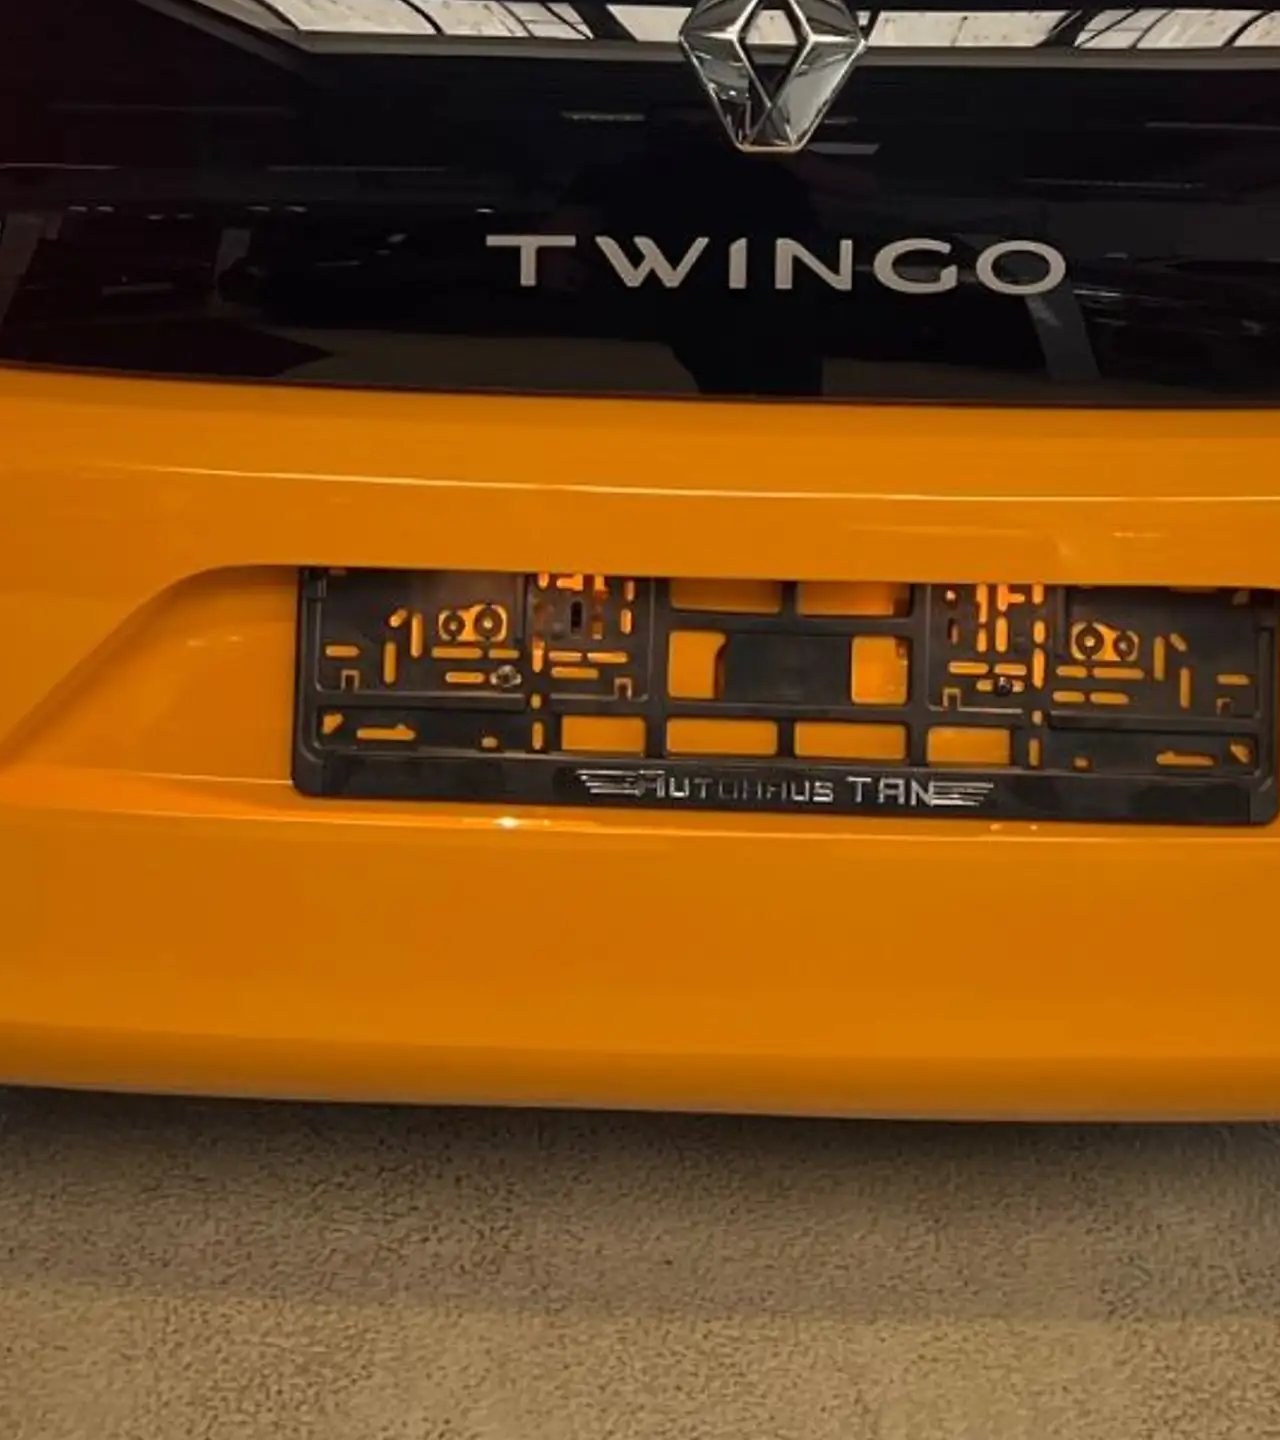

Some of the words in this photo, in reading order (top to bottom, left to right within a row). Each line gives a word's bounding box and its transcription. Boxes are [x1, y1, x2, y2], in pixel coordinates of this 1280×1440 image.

[485, 234, 1067, 295] TWINGO
[638, 769, 835, 802] AUTOHAUS
[845, 776, 935, 808] TAN
